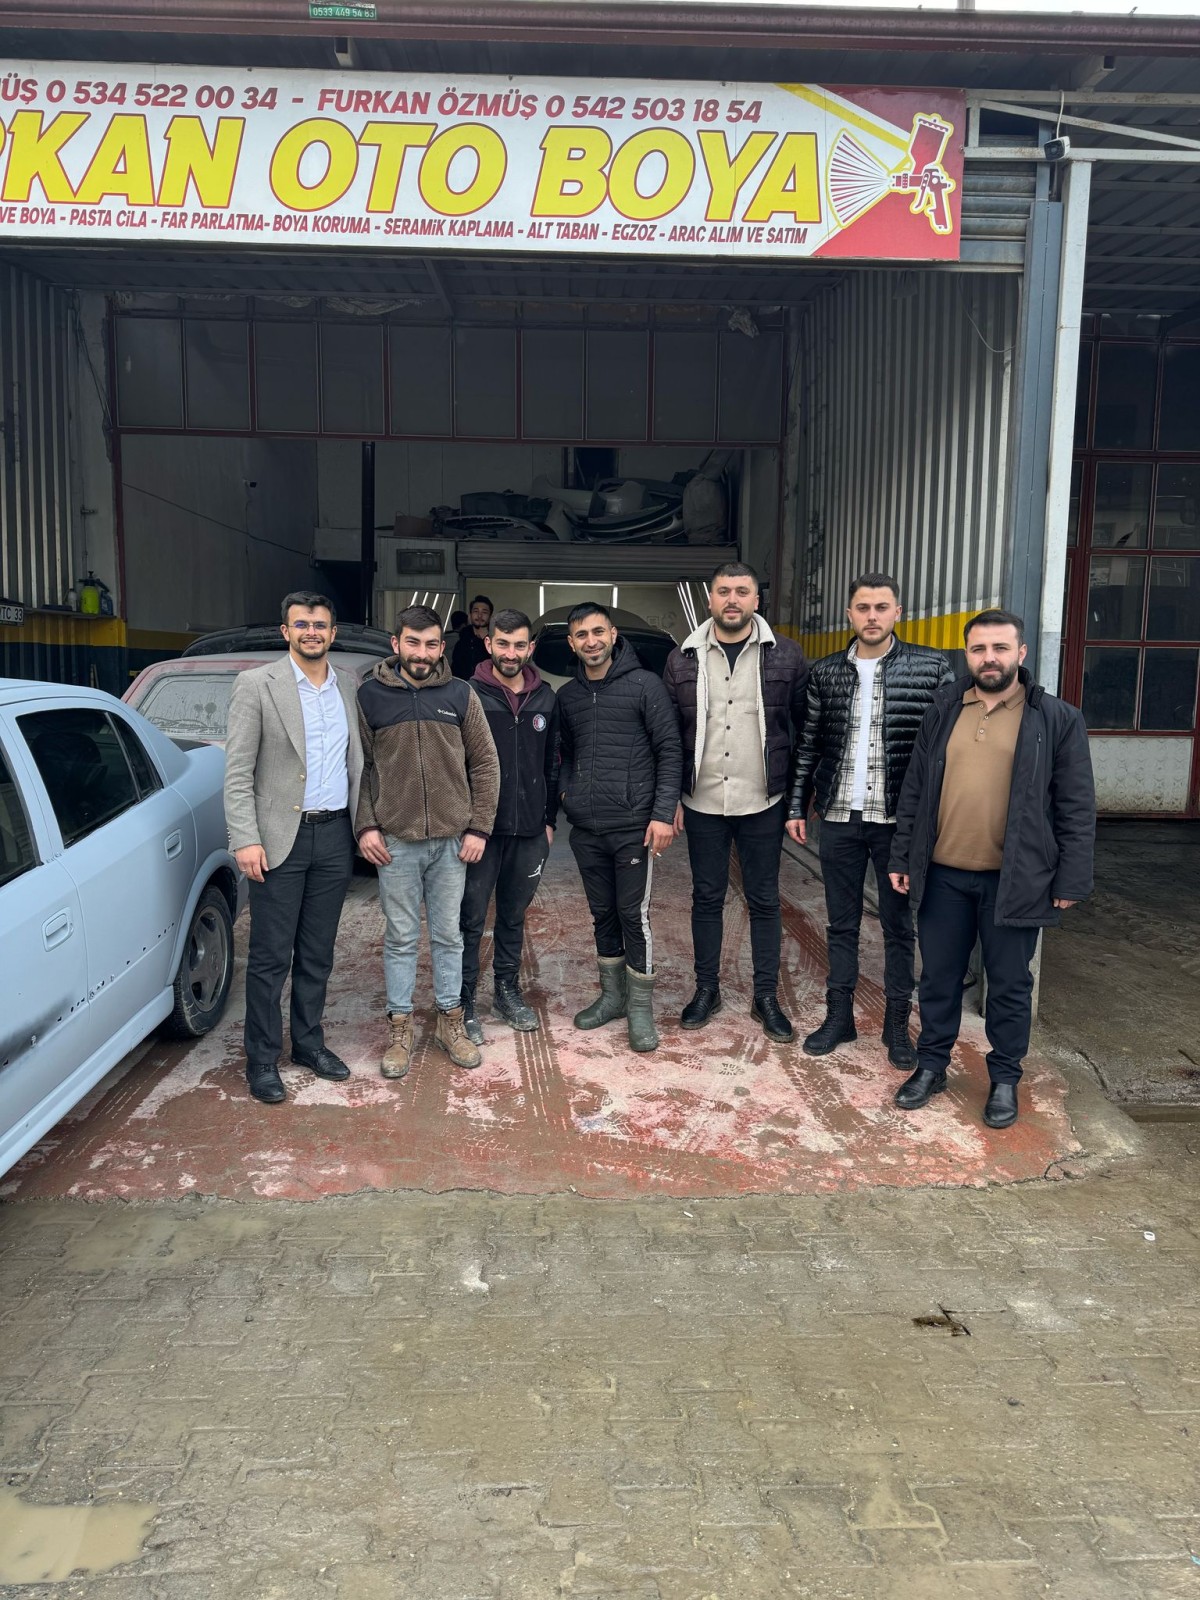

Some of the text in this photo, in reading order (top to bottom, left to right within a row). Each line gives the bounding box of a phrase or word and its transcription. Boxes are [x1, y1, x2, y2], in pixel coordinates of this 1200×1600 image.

[313, 8, 333, 16] 0533
[335, 8, 350, 17] 449
[352, 9, 362, 17] 54
[0, 72, 38, 105] ÜŞ
[73, 80, 127, 105] 534
[134, 83, 188, 107] 522
[195, 85, 235, 109] 00
[241, 86, 278, 110] 34
[317, 88, 431, 115] FURKAN
[437, 86, 538, 120] ÖZMÜŞ
[571, 95, 626, 119] 542
[631, 97, 686, 122] 503
[692, 98, 720, 123] 18
[725, 100, 762, 123] 54
[0, 109, 822, 224] KAN OTO BOYA
[0, 206, 17, 224] VE
[20, 207, 56, 225] BOYA
[69, 208, 112, 227] PASTA
[160, 211, 188, 229] FAR
[272, 214, 308, 232] BOYA
[312, 215, 370, 234] KORUMA
[448, 219, 514, 238] KAPLAMA
[527, 221, 554, 239] ALT
[556, 222, 600, 240] TABAN
[611, 223, 657, 241] EGZOZ
[708, 226, 744, 243] ALIM
[747, 227, 764, 243] VE
[766, 227, 808, 244] SATIM
[14, 608, 23, 621] 33
